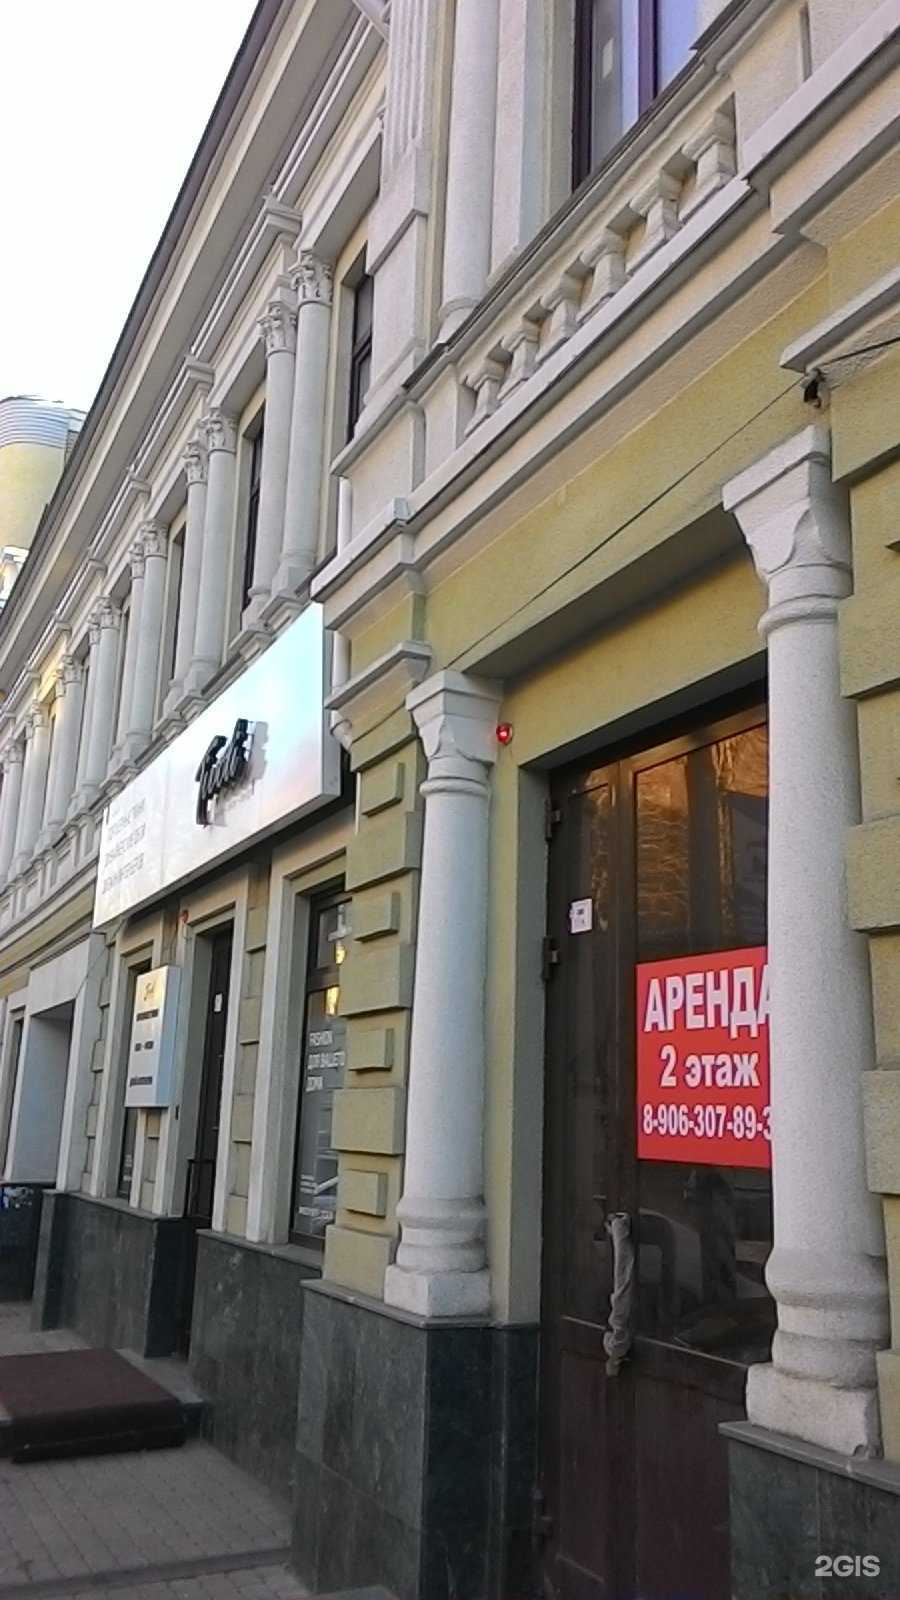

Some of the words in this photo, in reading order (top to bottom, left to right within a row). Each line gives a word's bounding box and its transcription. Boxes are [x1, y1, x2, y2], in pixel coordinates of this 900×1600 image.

[643, 964, 771, 1039] АРЕНДА
[660, 1045, 677, 1087] 2
[685, 1052, 760, 1088] этаж
